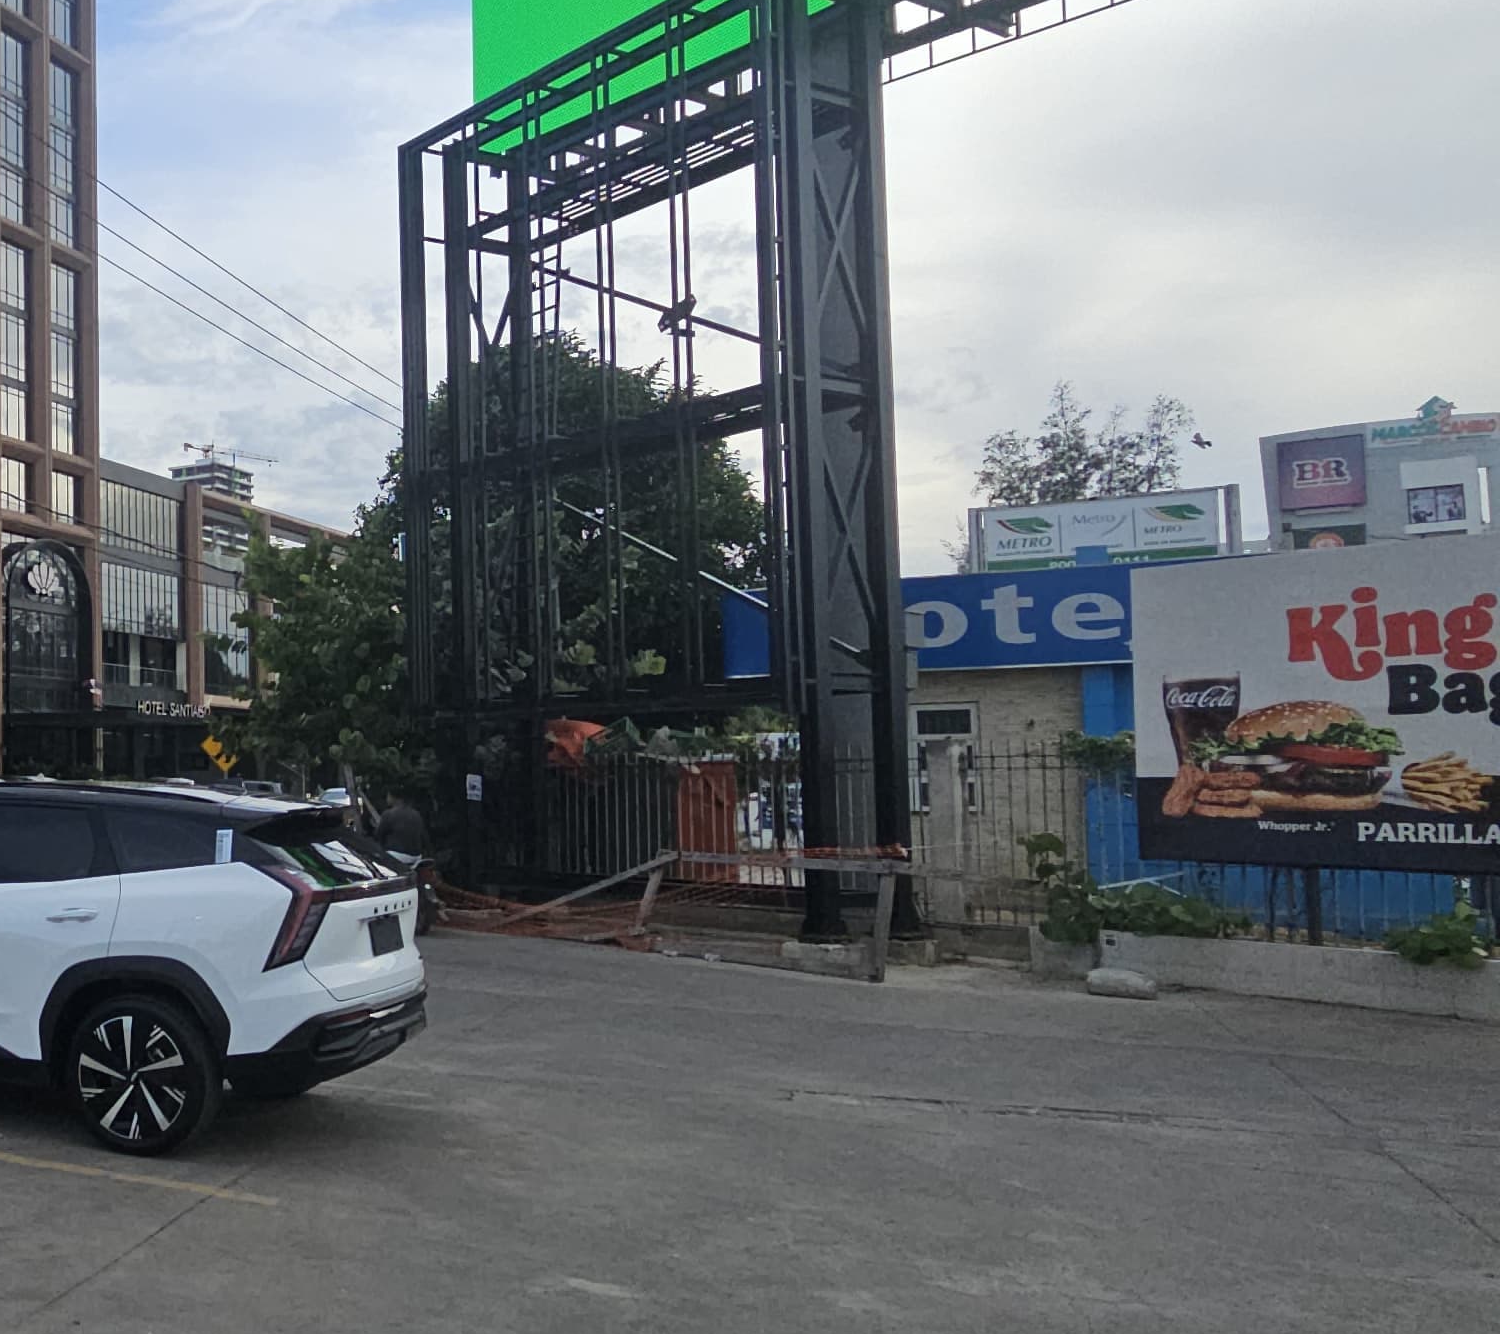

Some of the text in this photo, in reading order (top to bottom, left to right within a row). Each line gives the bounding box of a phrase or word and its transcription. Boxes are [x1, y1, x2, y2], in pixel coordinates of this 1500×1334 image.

[1294, 458, 1349, 481] BR
[1072, 514, 1116, 525] Metro
[997, 536, 1052, 551] METRO
[1286, 586, 1498, 681] King
[1386, 663, 1500, 726] Ba
[137, 699, 167, 716] HOTEL
[1257, 820, 1311, 833] Whopper
